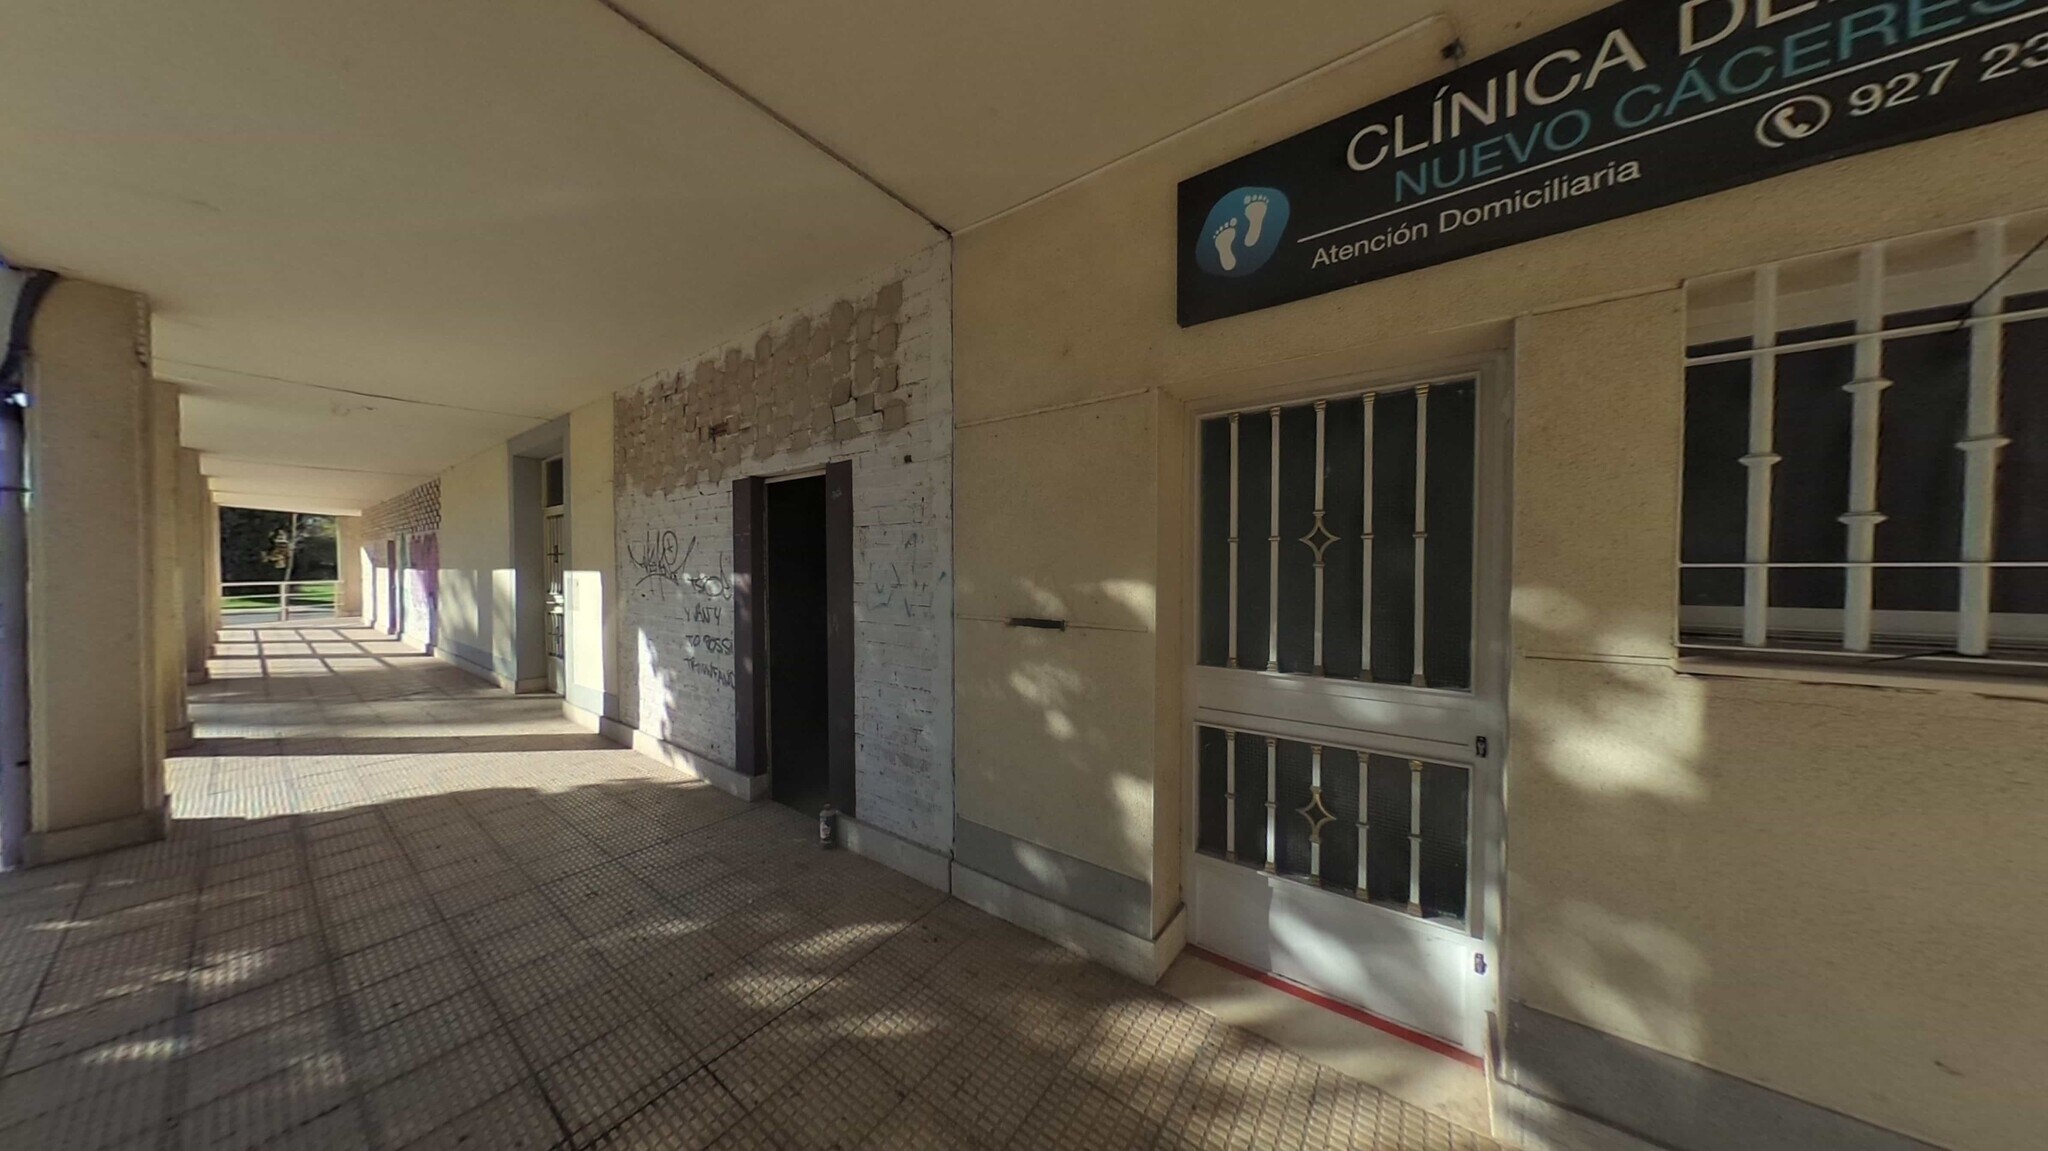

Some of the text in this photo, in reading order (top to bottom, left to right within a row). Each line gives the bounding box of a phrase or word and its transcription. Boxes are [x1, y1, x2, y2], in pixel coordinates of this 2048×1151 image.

[1346, 28, 1648, 172] CLÍNICA
[1849, 58, 1960, 117] 927
[1395, 108, 1591, 203] NUEVO
[1311, 159, 1642, 269] Atención Domiciliaria
